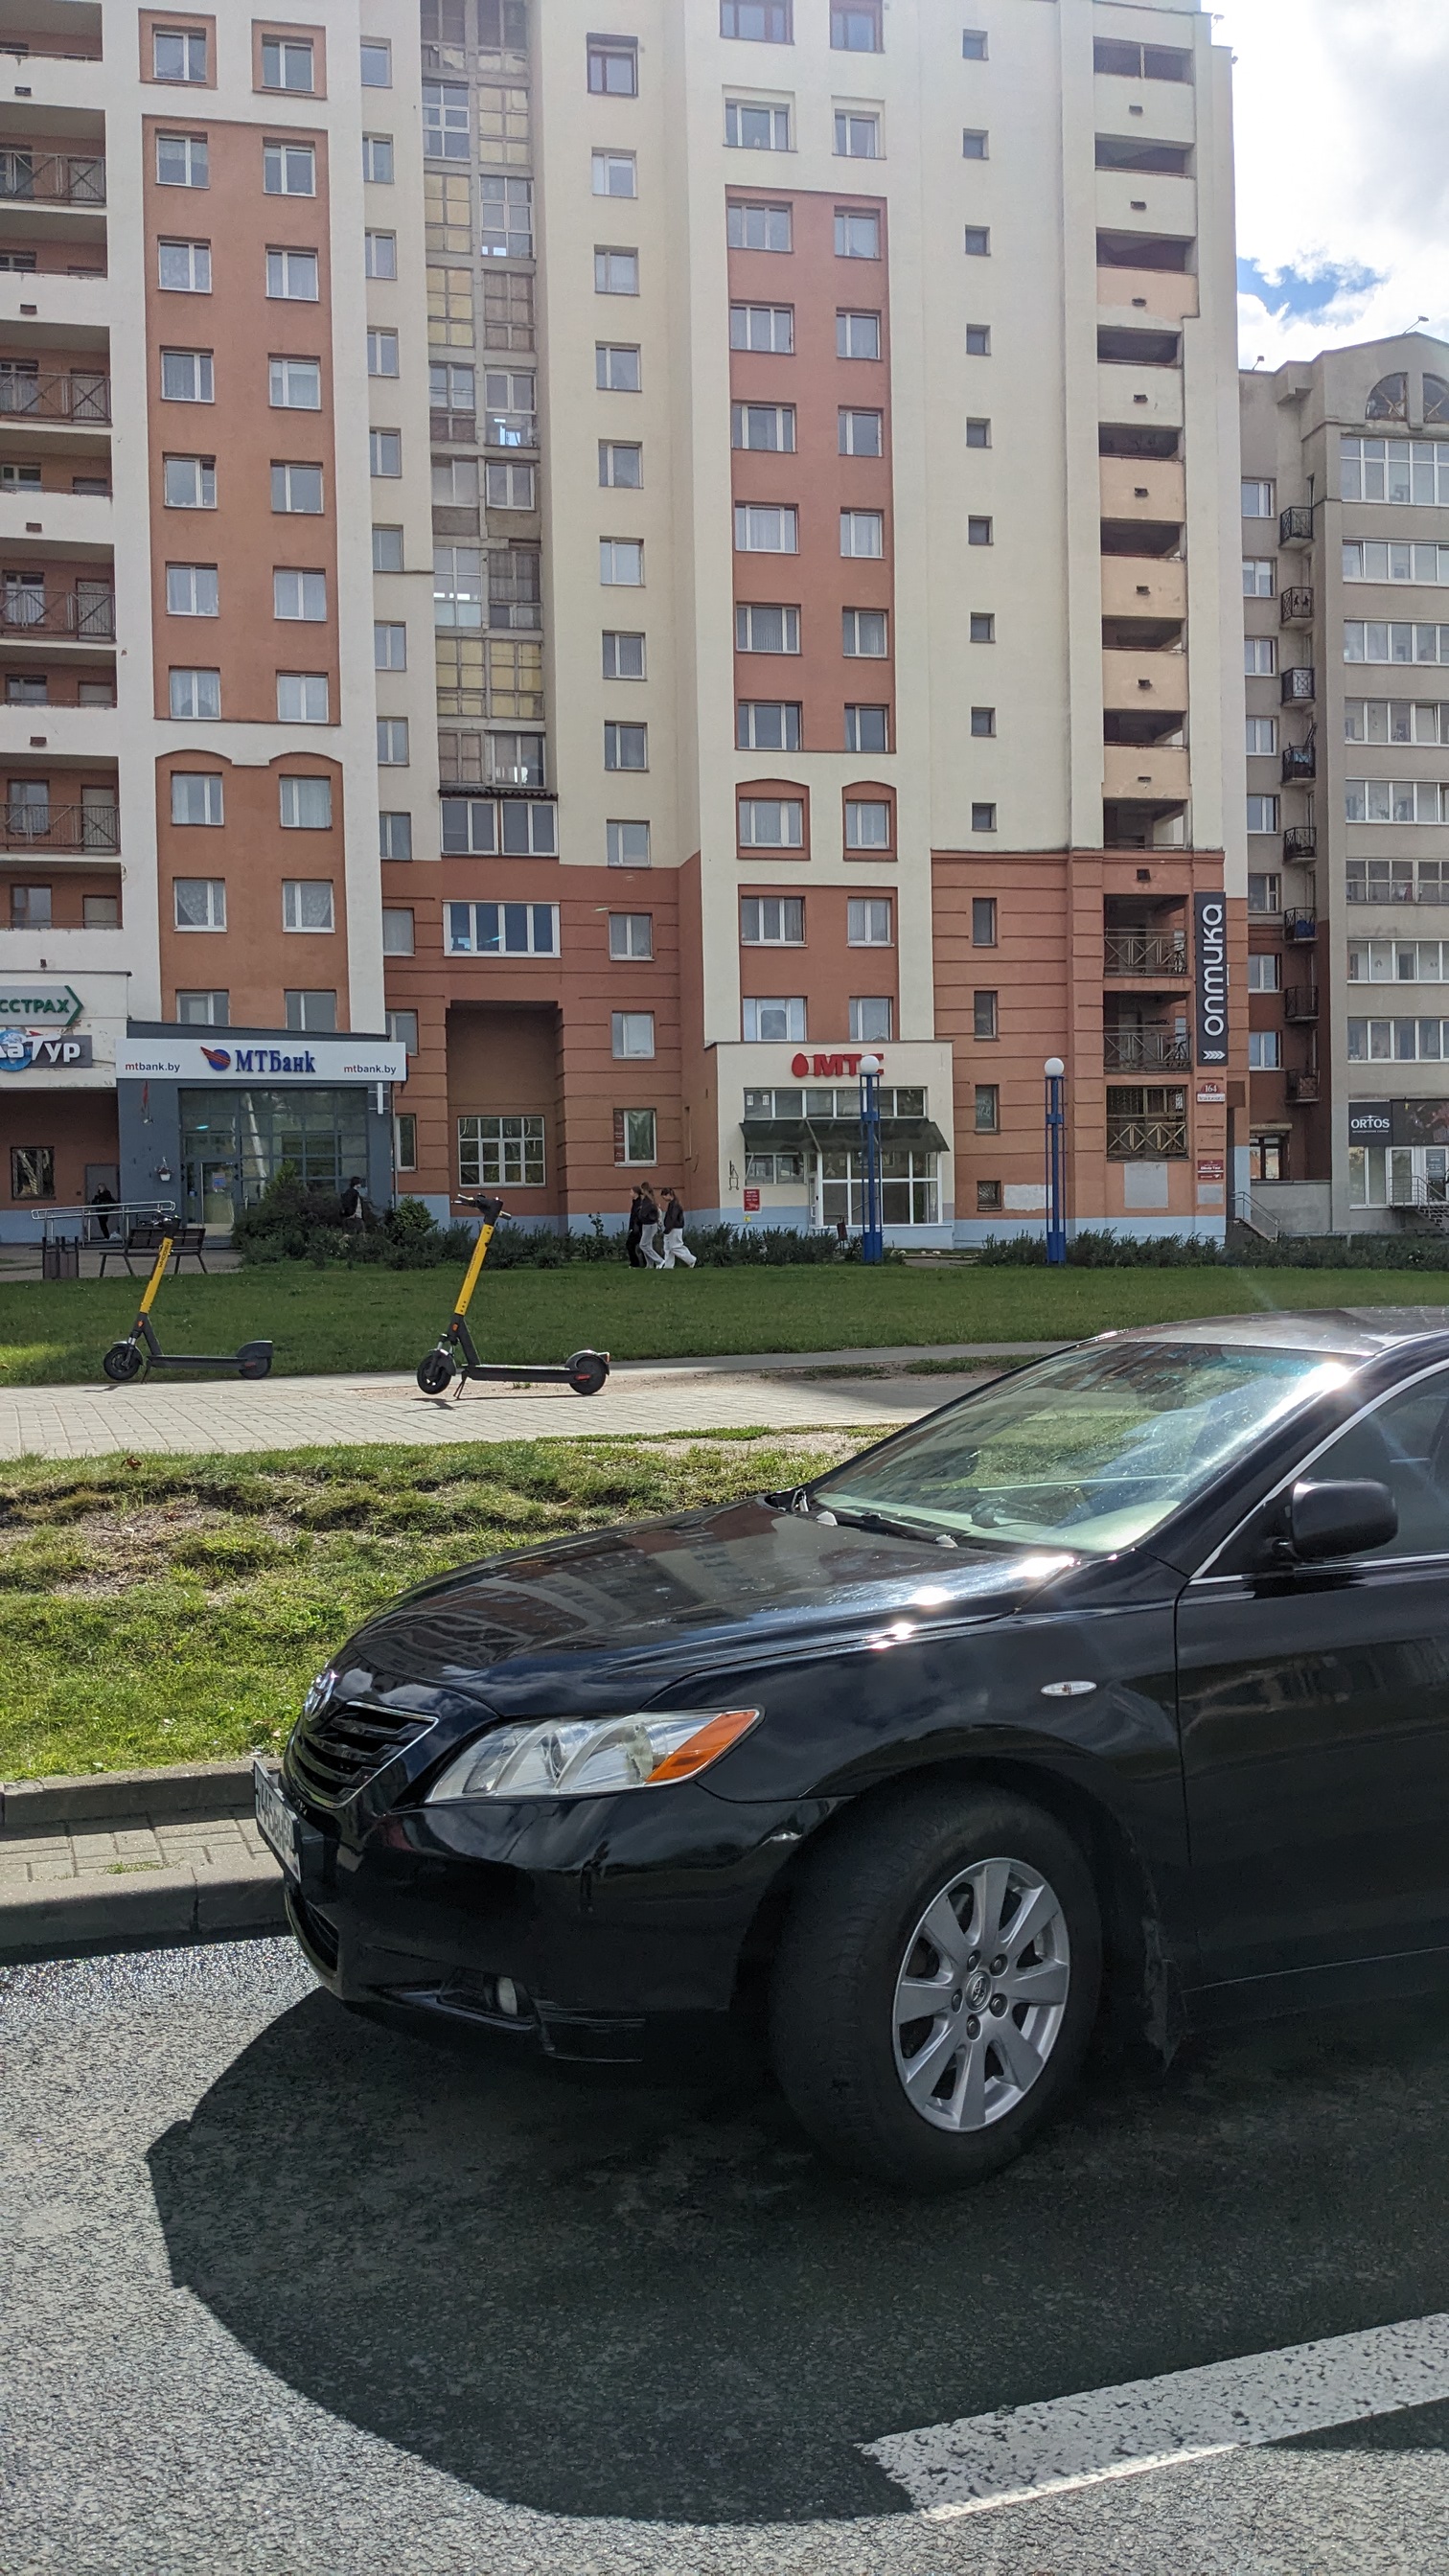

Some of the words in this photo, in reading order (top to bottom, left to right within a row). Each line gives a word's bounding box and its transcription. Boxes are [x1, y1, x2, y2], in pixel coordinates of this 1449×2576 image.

[1202, 904, 1224, 1037] оптика
[235, 1049, 316, 1072] МТБанк
[125, 1063, 180, 1072] mtbank.by
[343, 1065, 397, 1075] mtbank.by
[1205, 1084, 1217, 1092] 164
[1350, 1118, 1391, 1129] ORTOS
